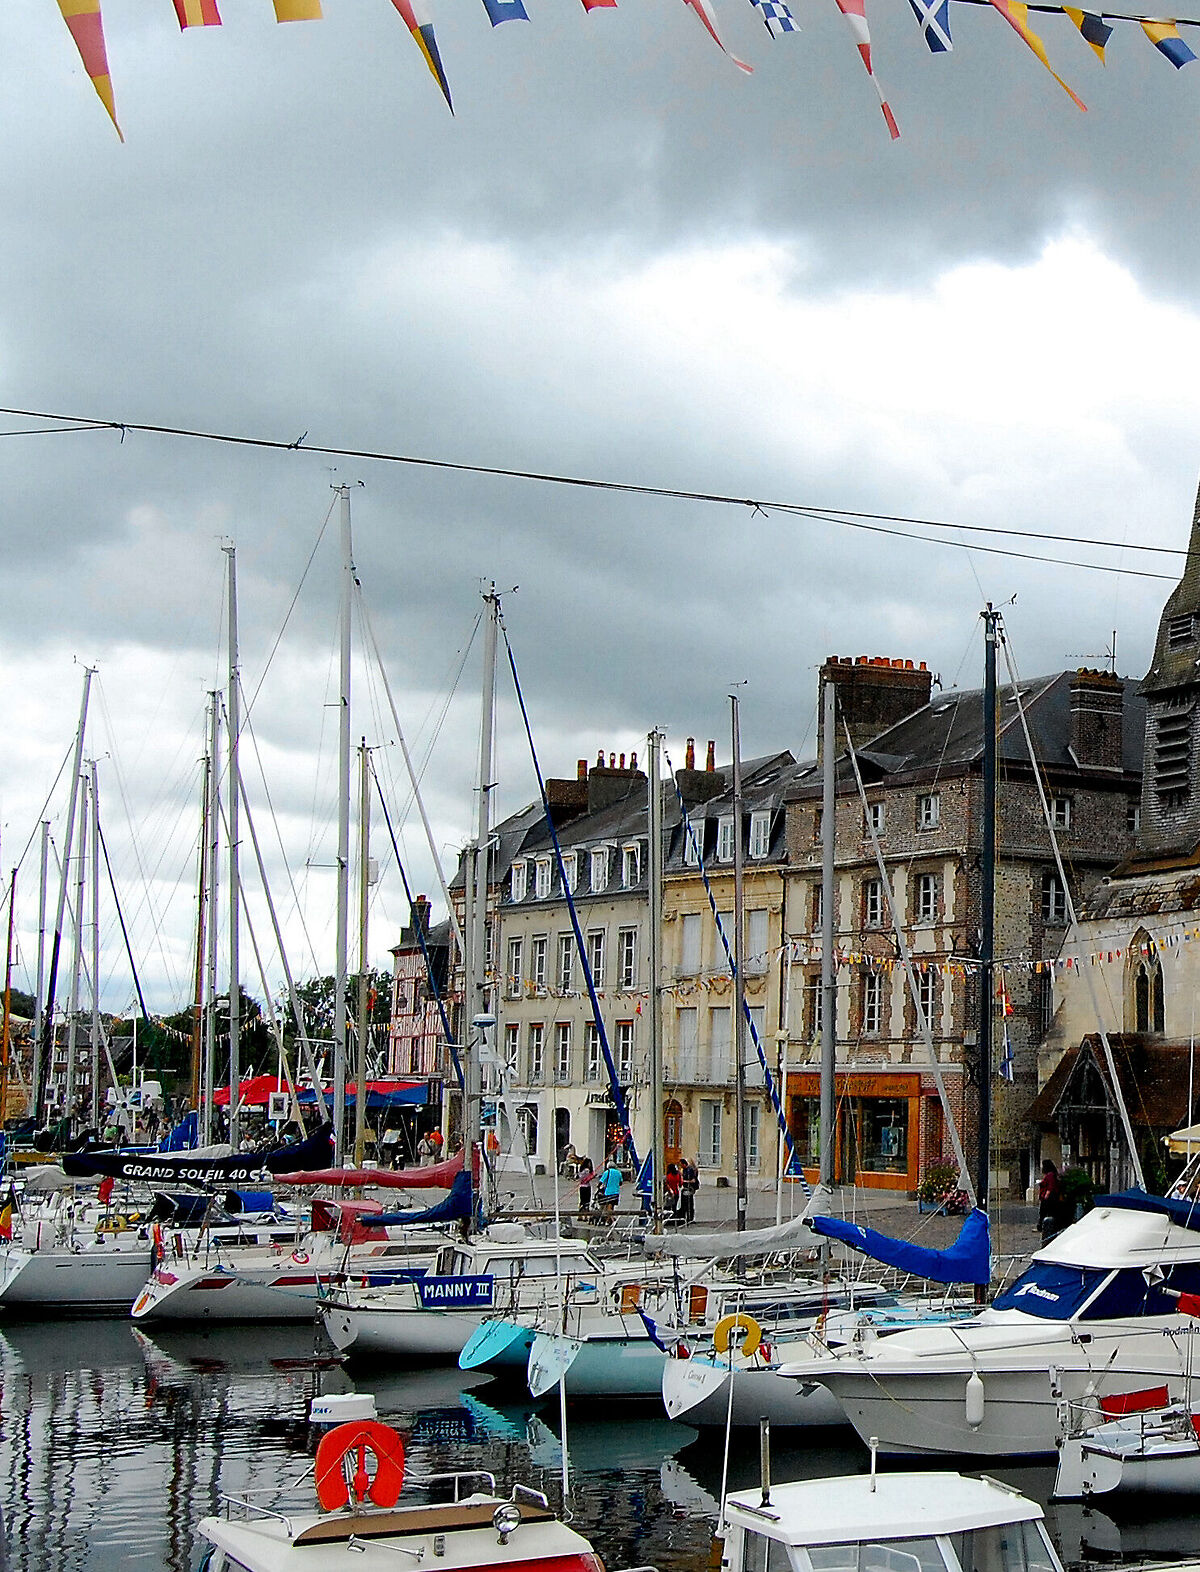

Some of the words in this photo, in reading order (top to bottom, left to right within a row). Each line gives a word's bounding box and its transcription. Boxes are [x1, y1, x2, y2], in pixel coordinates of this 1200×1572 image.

[122, 1163, 175, 1178] GRAND
[178, 1168, 225, 1180] SOLEIL
[228, 1168, 248, 1180] 40
[423, 1283, 473, 1299] MANNY
[476, 1282, 490, 1296] III
